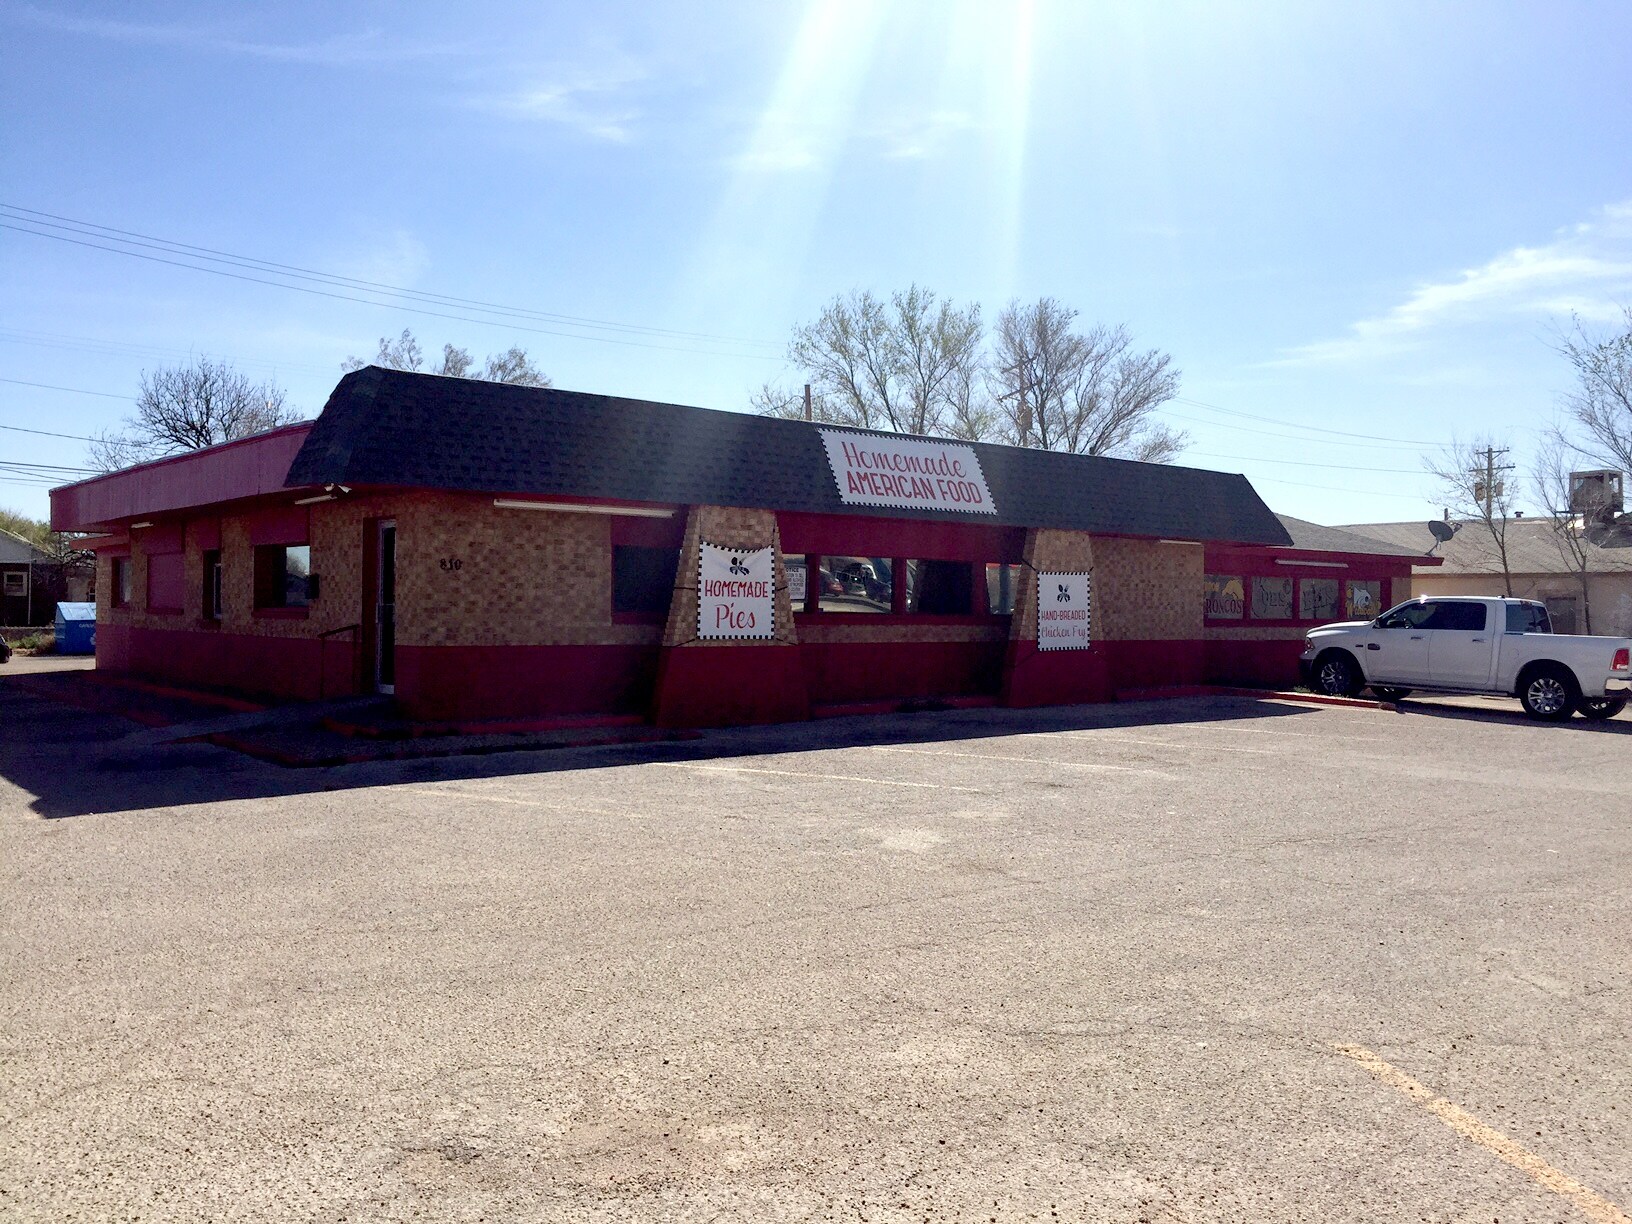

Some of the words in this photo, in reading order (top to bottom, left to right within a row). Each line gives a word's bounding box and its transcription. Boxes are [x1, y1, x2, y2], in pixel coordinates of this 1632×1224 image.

[841, 441, 967, 478] Homemade
[846, 470, 937, 500] AMERICAN
[936, 479, 983, 504] FOOD
[440, 558, 462, 570] 810
[704, 579, 769, 598] HOMEMADE
[714, 602, 756, 629] Pies
[1041, 610, 1086, 621] HAND-BREADED
[1205, 598, 1244, 615] RONCOS
